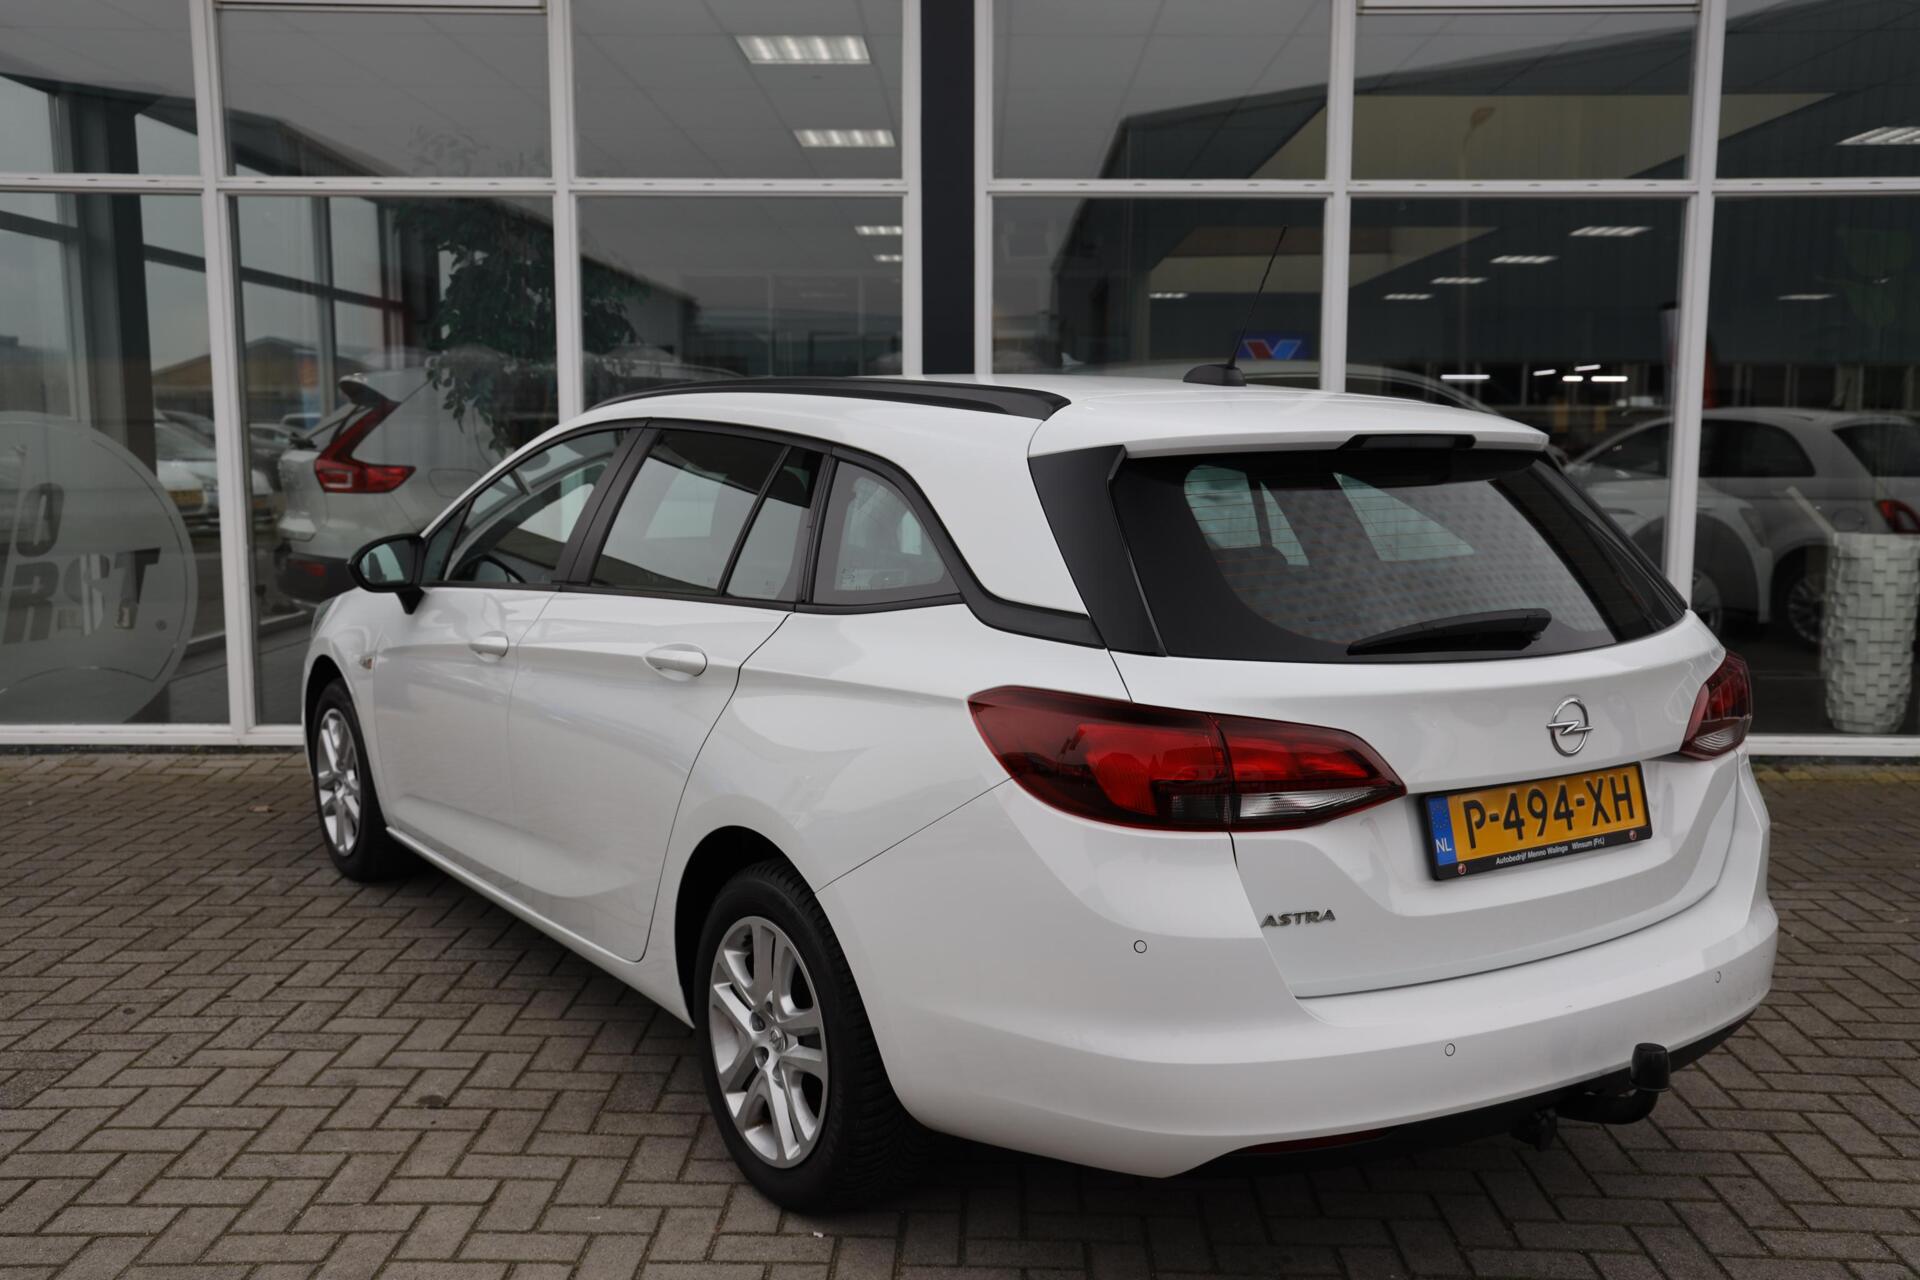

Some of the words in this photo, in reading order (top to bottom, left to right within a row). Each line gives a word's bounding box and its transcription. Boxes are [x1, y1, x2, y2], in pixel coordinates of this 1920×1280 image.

[1463, 775, 1634, 849] P-494-XH
[1435, 838, 1452, 852] NL
[1495, 852, 1527, 865] Autobedrijf
[1527, 849, 1547, 858] Menno
[1261, 908, 1336, 929] ASTRA
